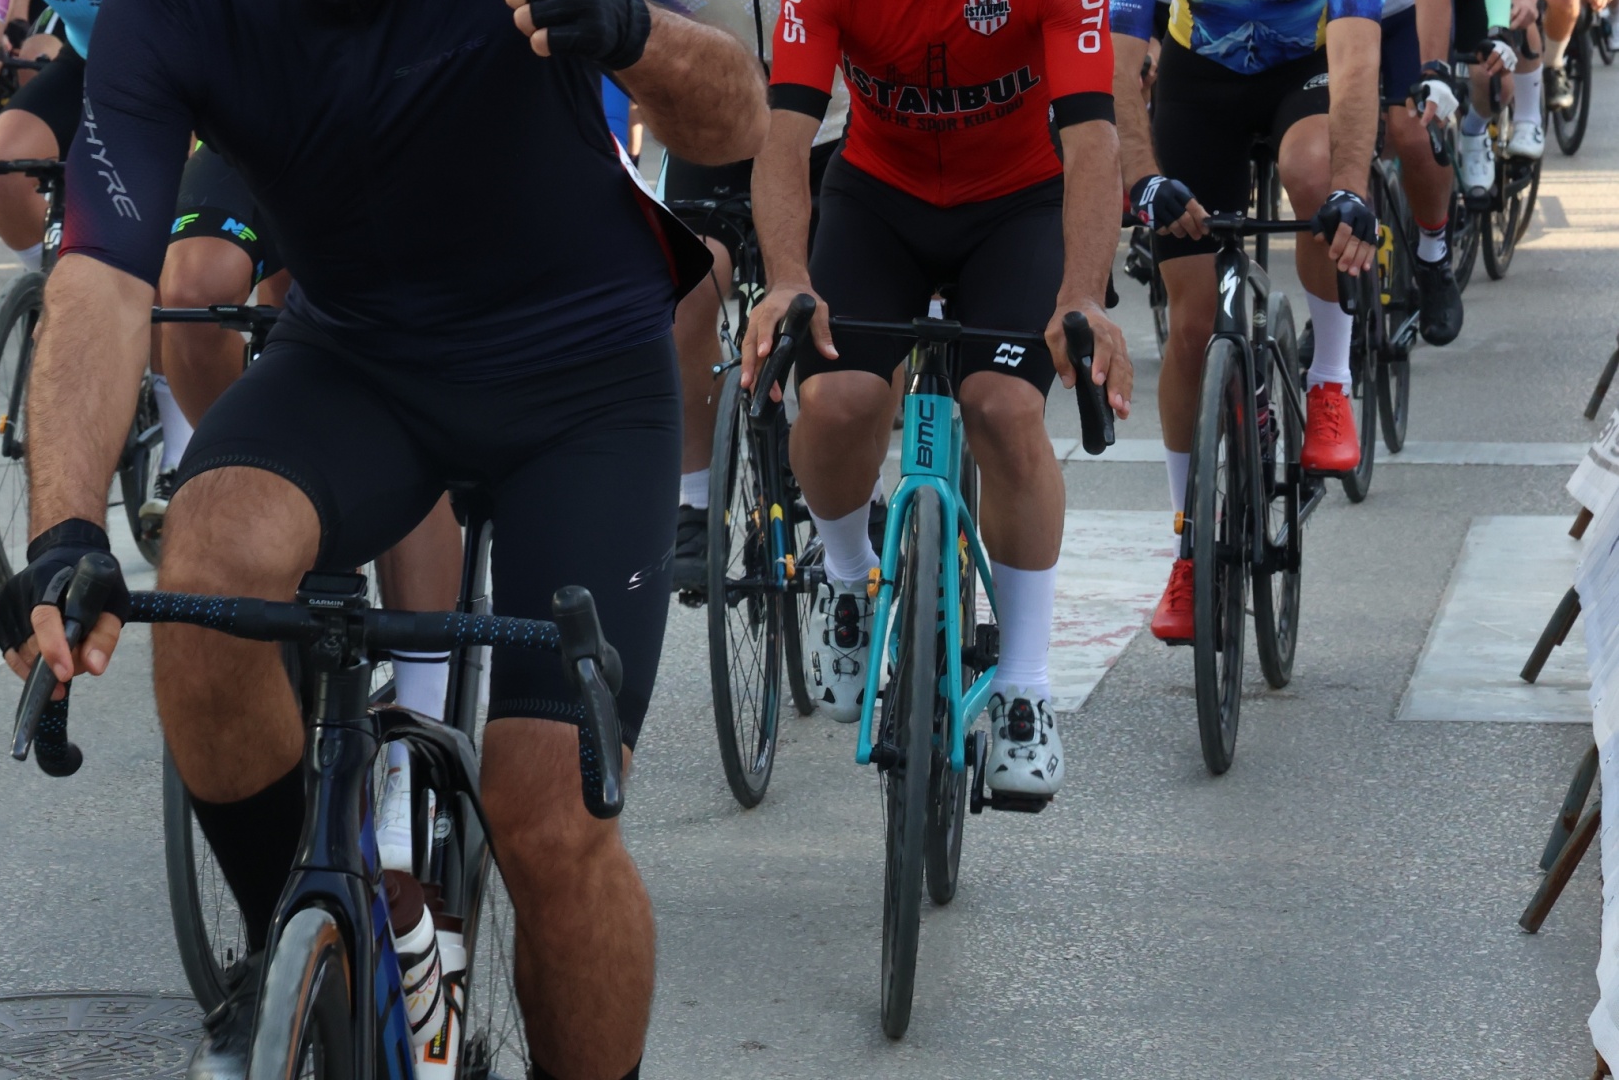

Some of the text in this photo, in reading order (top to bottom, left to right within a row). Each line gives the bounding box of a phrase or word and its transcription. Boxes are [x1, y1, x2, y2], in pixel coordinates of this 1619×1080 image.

[964, 0, 1010, 18] İSTANBUL
[842, 51, 1042, 116] İSTANBUL
[914, 399, 936, 468] BMC
